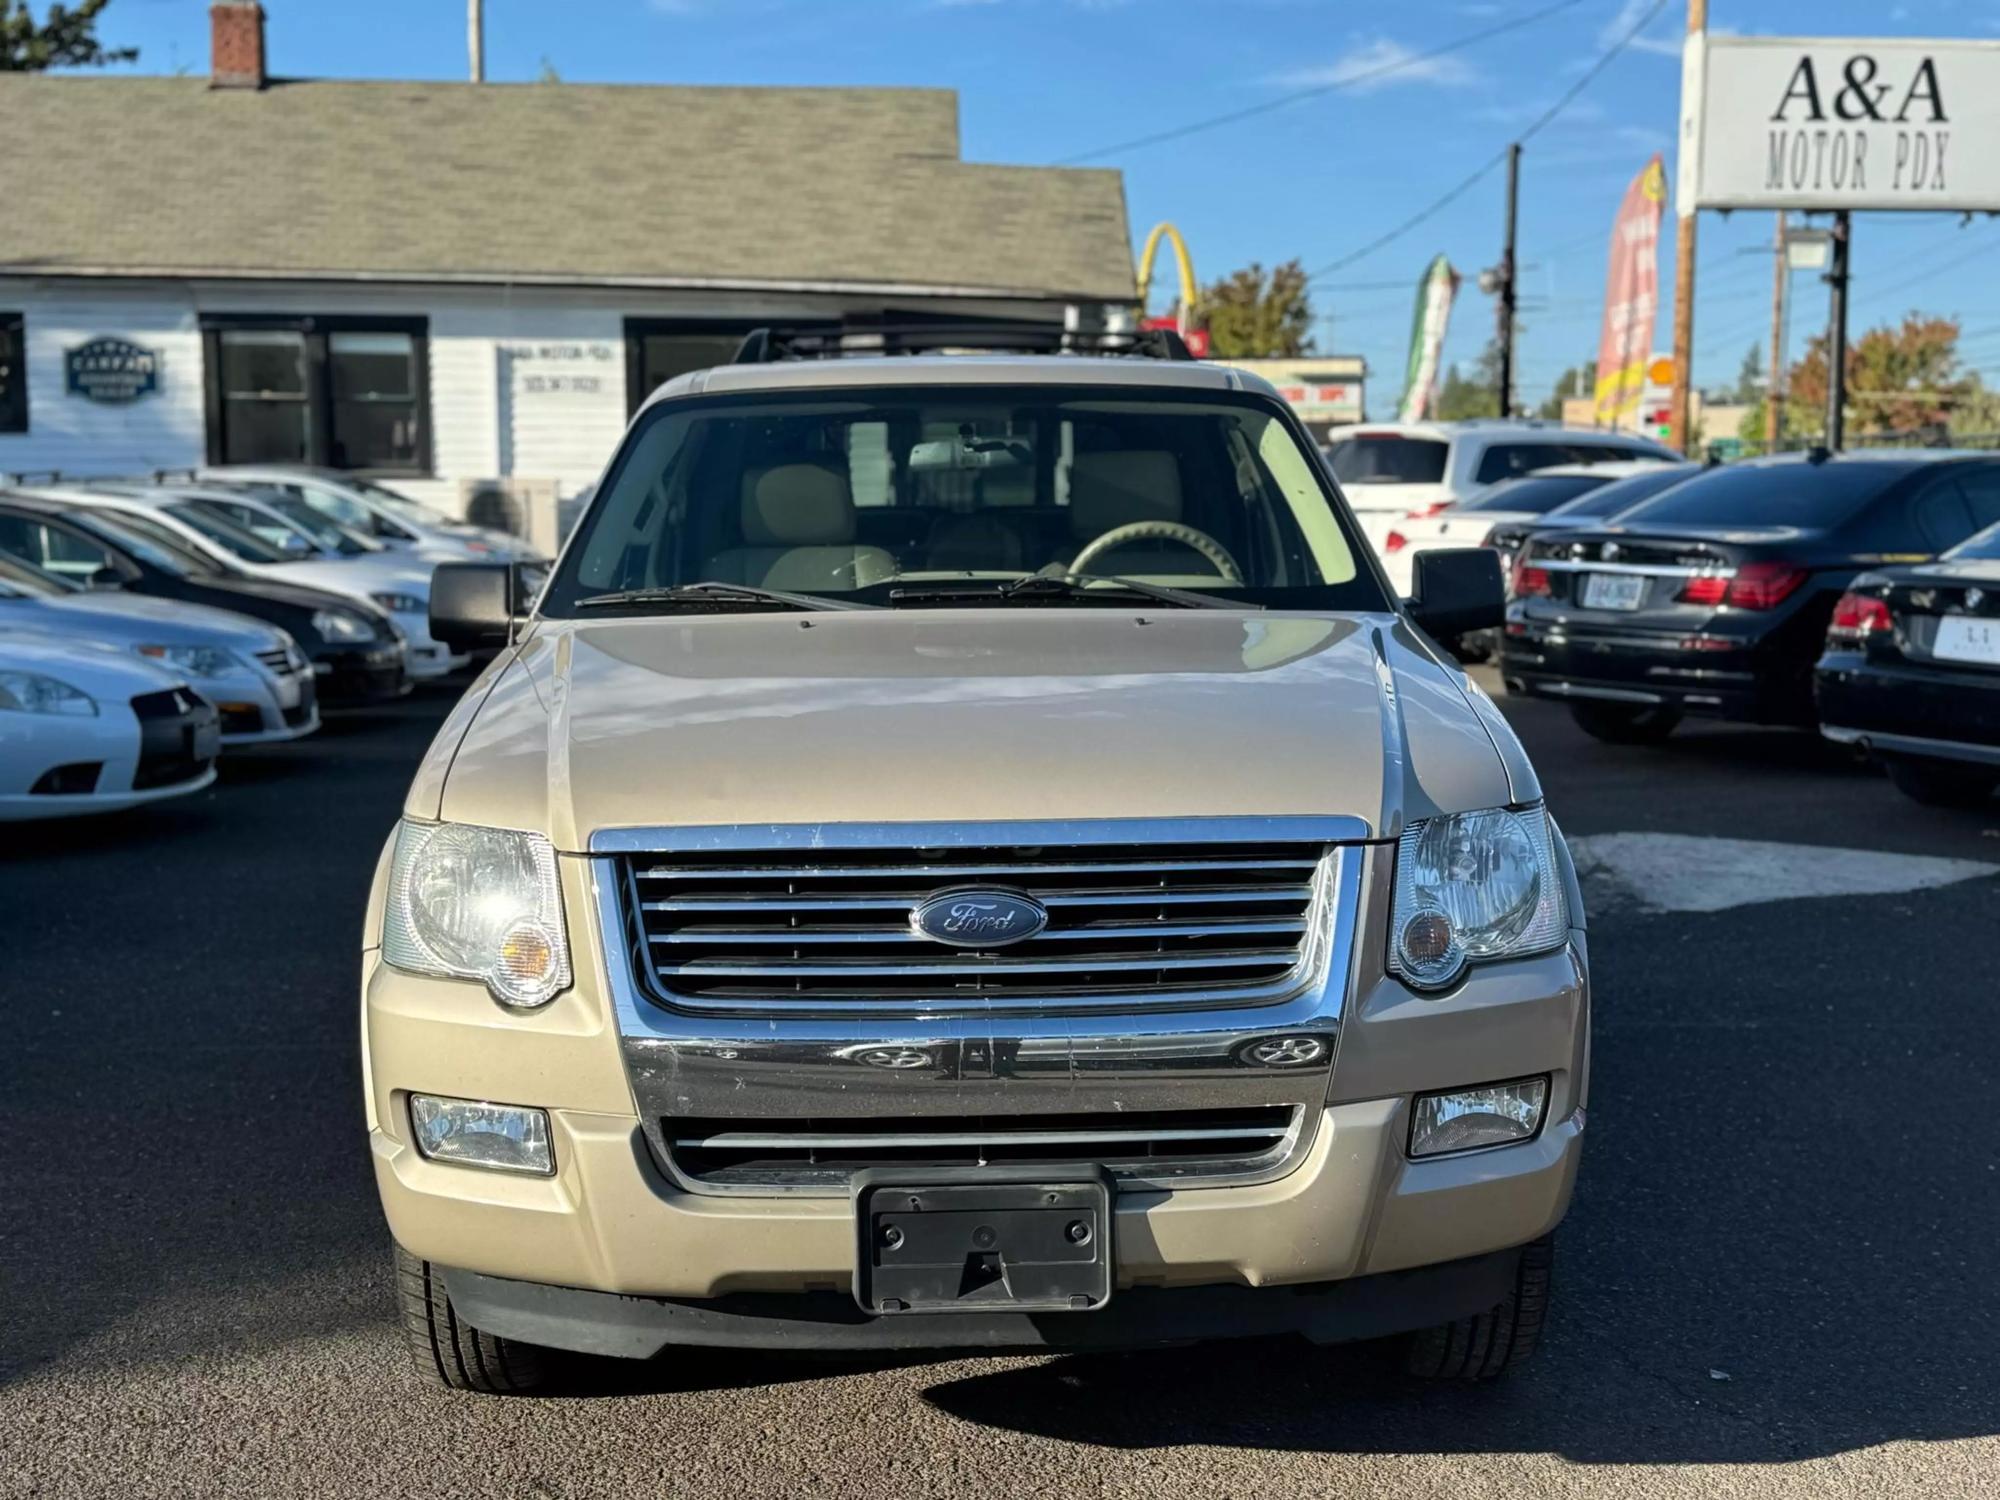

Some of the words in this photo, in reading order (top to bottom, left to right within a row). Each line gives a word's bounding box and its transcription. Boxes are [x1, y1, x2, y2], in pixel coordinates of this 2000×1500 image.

[1769, 54, 1949, 122] A&A
[1765, 130, 1868, 190] MOTOR
[1893, 131, 1950, 190] PDX
[944, 903, 1015, 931] Ford
